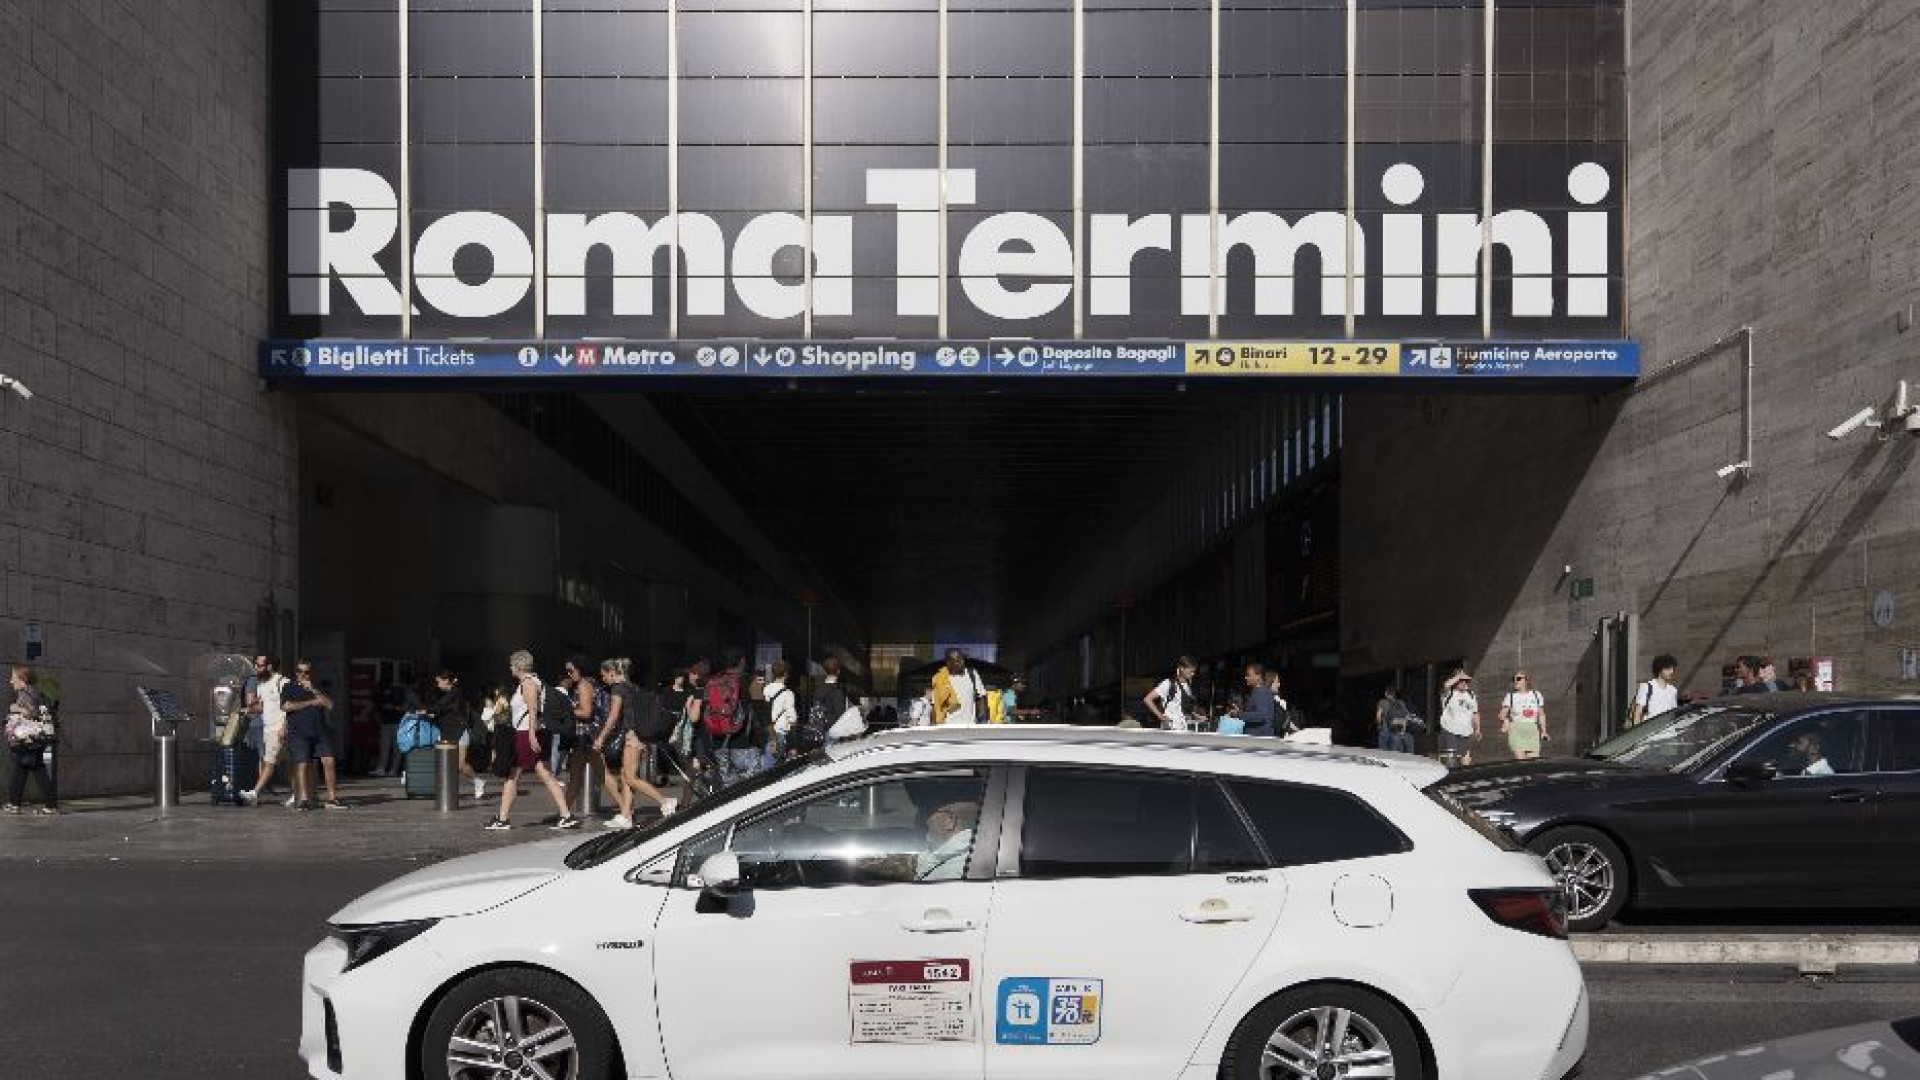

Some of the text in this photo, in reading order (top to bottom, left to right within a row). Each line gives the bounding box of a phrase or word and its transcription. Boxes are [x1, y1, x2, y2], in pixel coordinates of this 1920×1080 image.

[318, 345, 475, 370] Biglietti Tickets
[603, 346, 676, 366] Metro
[802, 345, 916, 370] Shopping
[1042, 345, 1176, 362] Deposito Bagagli
[1240, 347, 1287, 359] Binari
[1456, 347, 1618, 363] Fiumicino Aeroporto
